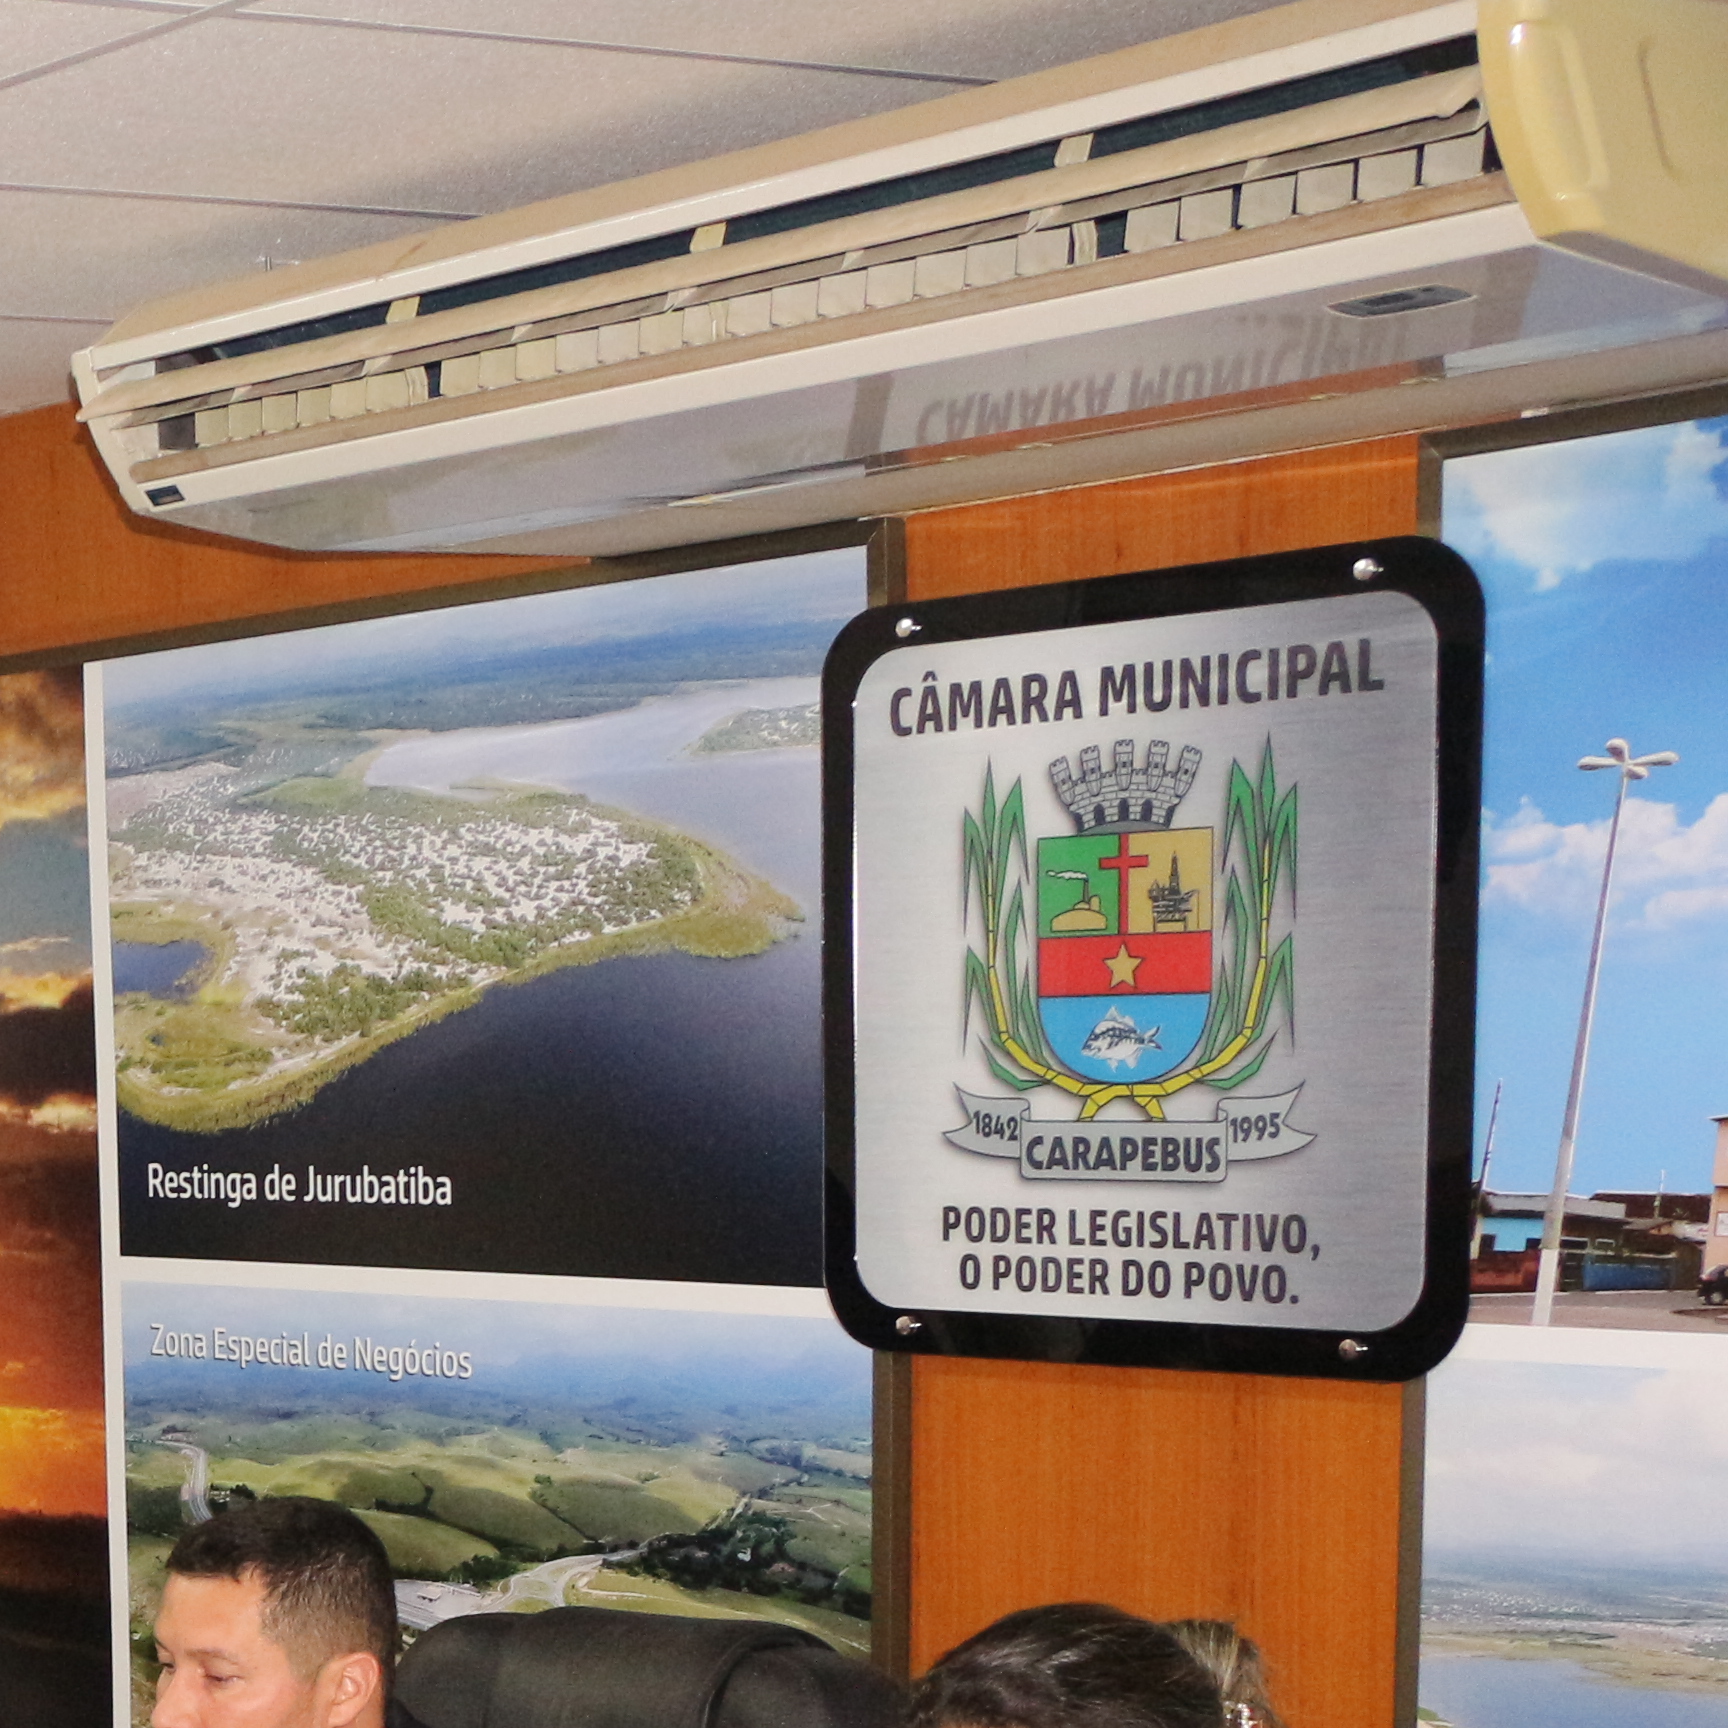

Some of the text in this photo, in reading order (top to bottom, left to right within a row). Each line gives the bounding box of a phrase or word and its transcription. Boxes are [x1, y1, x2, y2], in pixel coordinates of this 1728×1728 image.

[889, 637, 1385, 738] CÂMARA MUNICIPAL
[973, 1109, 1019, 1142] 1842
[1230, 1111, 1281, 1144] 1995
[1025, 1134, 1222, 1174] CARAPEBUS
[147, 1162, 453, 1208] Restinga de Jurubatiba
[943, 1206, 1321, 1260] PODER LEGISLATIVO,
[959, 1253, 1300, 1305] O PODER DO POVO.
[149, 1323, 473, 1382] Zona Especial de Negócios
